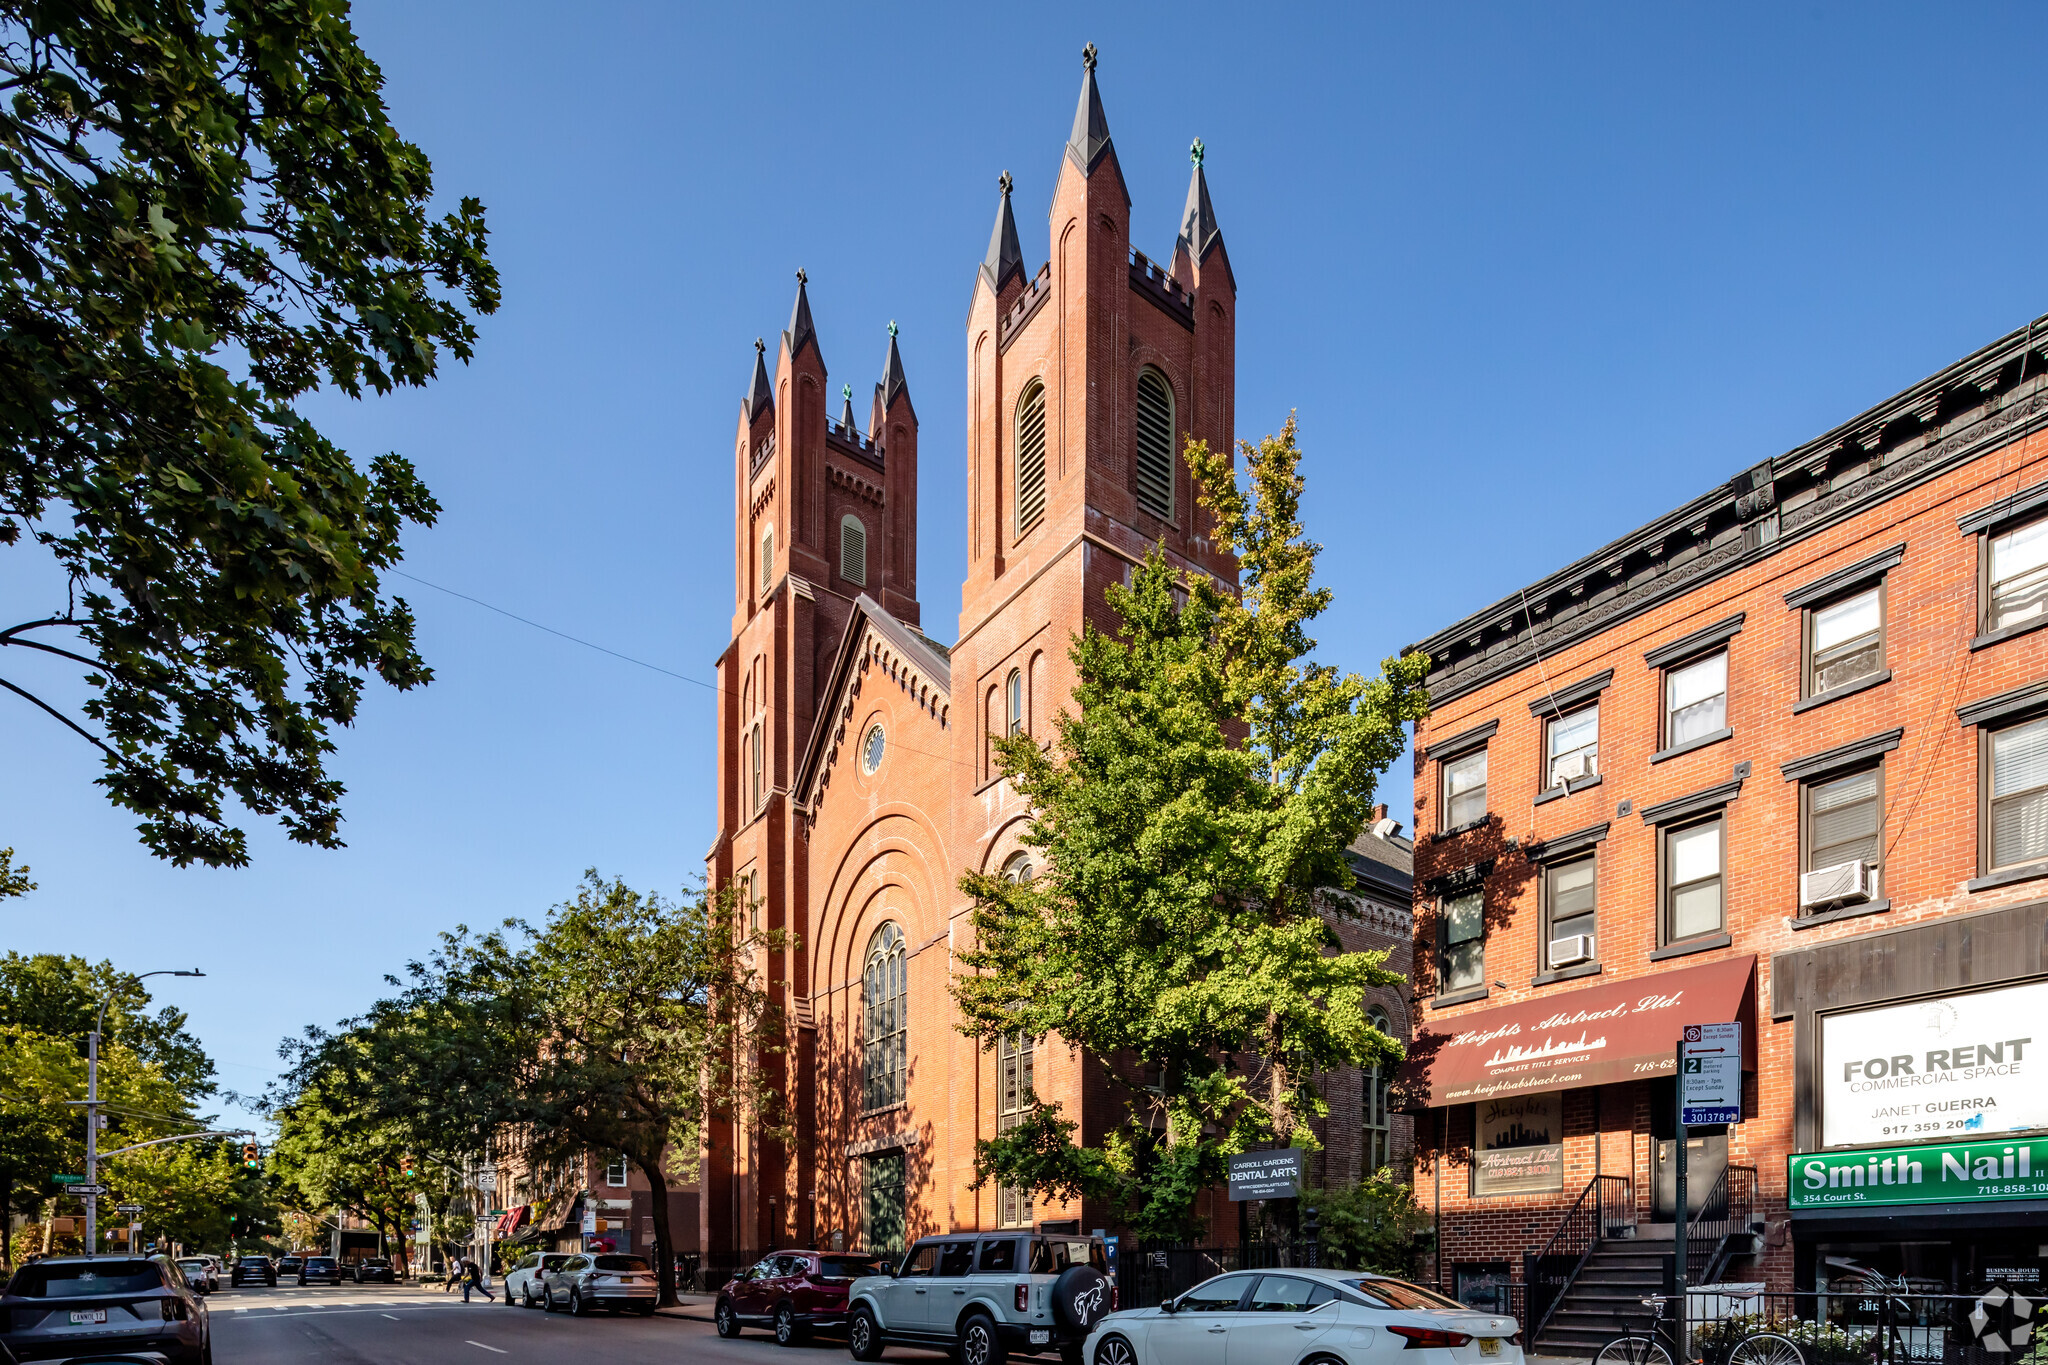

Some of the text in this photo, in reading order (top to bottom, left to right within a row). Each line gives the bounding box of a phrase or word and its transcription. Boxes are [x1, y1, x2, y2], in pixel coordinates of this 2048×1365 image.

[1449, 991, 1684, 1047] Heights Abstract, Ltd.
[1490, 1054, 1591, 1075] COMPLETE TITLE SERVICES
[1688, 1059, 1697, 1073] 2
[1844, 1037, 2032, 1082] FOR RENT
[1446, 1074, 1583, 1099] www.heightsabstract.com
[1851, 1062, 2021, 1093] COMMERCIAL SPACE
[1871, 1103, 1921, 1119] JANET
[1925, 1096, 1997, 1113] GUERRA
[1691, 1113, 1725, 1122] 301378
[1882, 1119, 1964, 1135] 917.359.20
[1233, 1157, 1294, 1170] CARROLL GARDENS
[1481, 1147, 1560, 1169] Abstract Ltd.
[1230, 1167, 1298, 1182] DENTAL ARTS
[1803, 1146, 2044, 1189] Smith Nail II
[1803, 1192, 1867, 1203] 354 Court St.
[1977, 1183, 2048, 1195] 718-858-10
[1108, 1245, 1115, 1257] P
